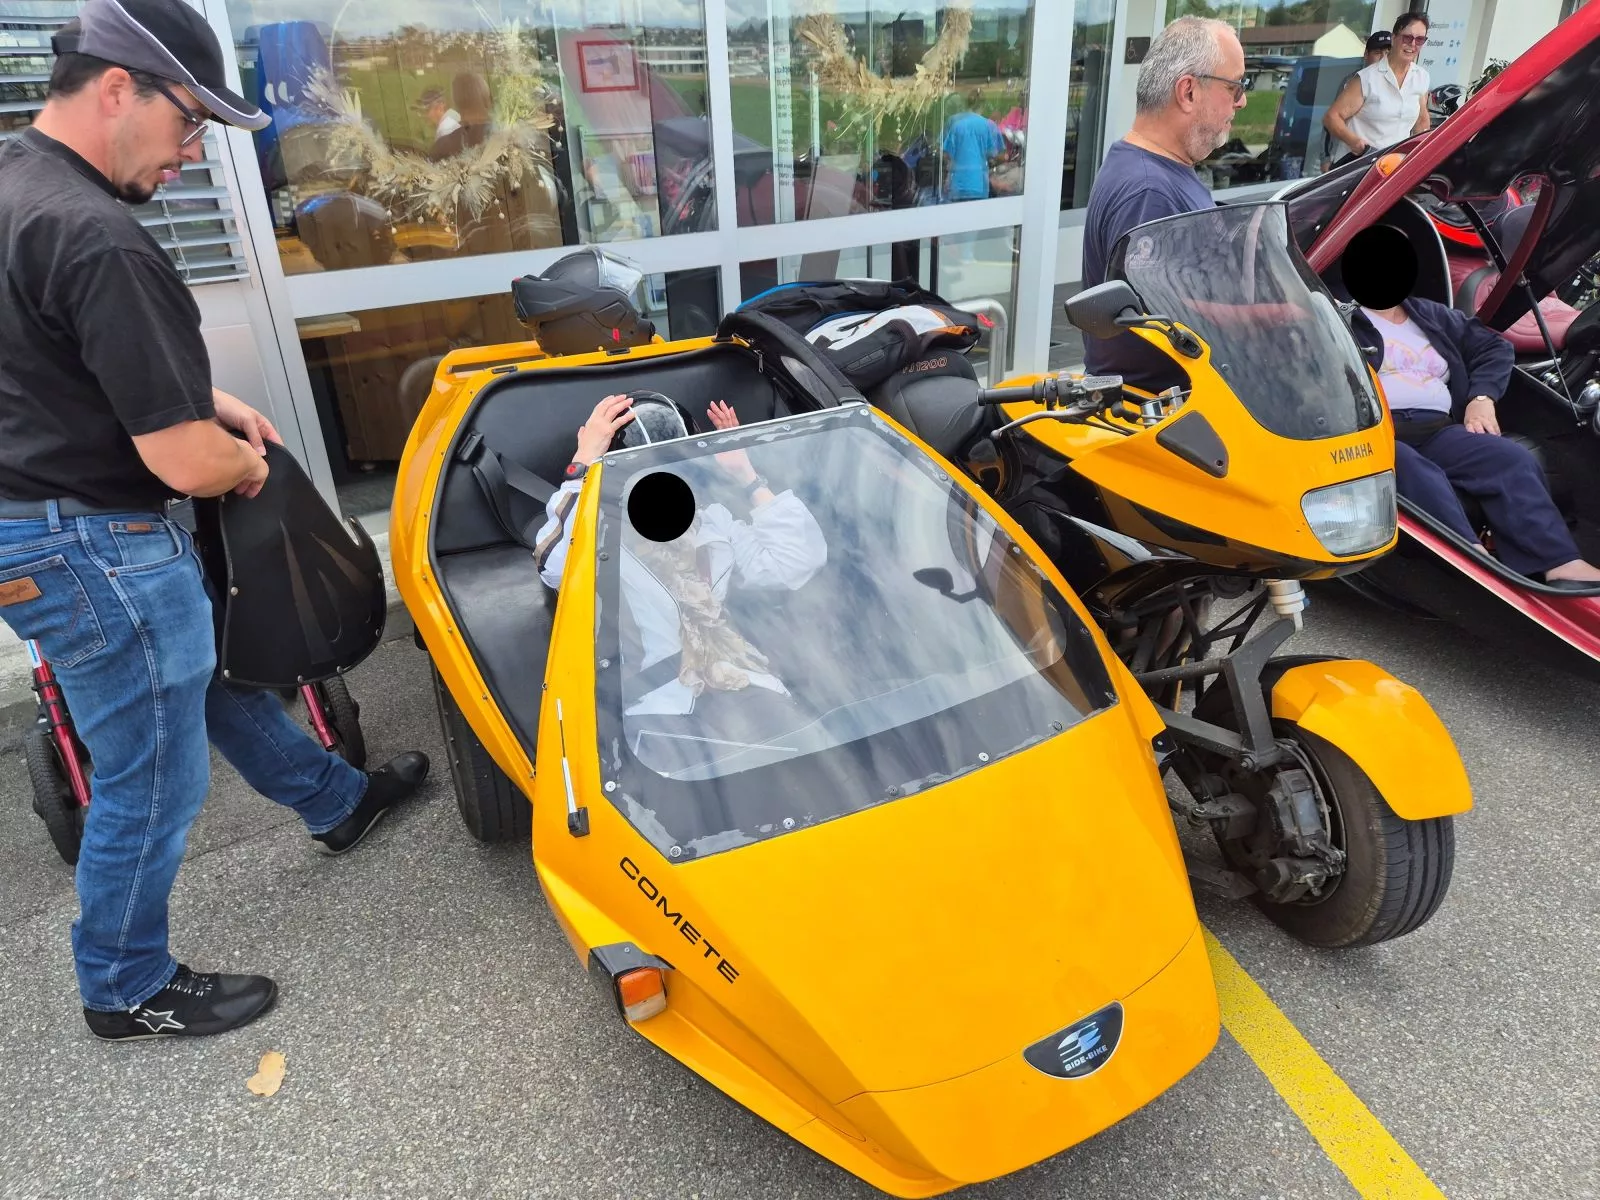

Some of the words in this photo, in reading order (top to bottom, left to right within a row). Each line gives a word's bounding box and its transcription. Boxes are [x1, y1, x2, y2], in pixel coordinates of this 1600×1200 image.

[1330, 442, 1374, 464] YAMAHA
[619, 856, 740, 984] COMETE
[1064, 1044, 1108, 1072] SIDE-BIKE
